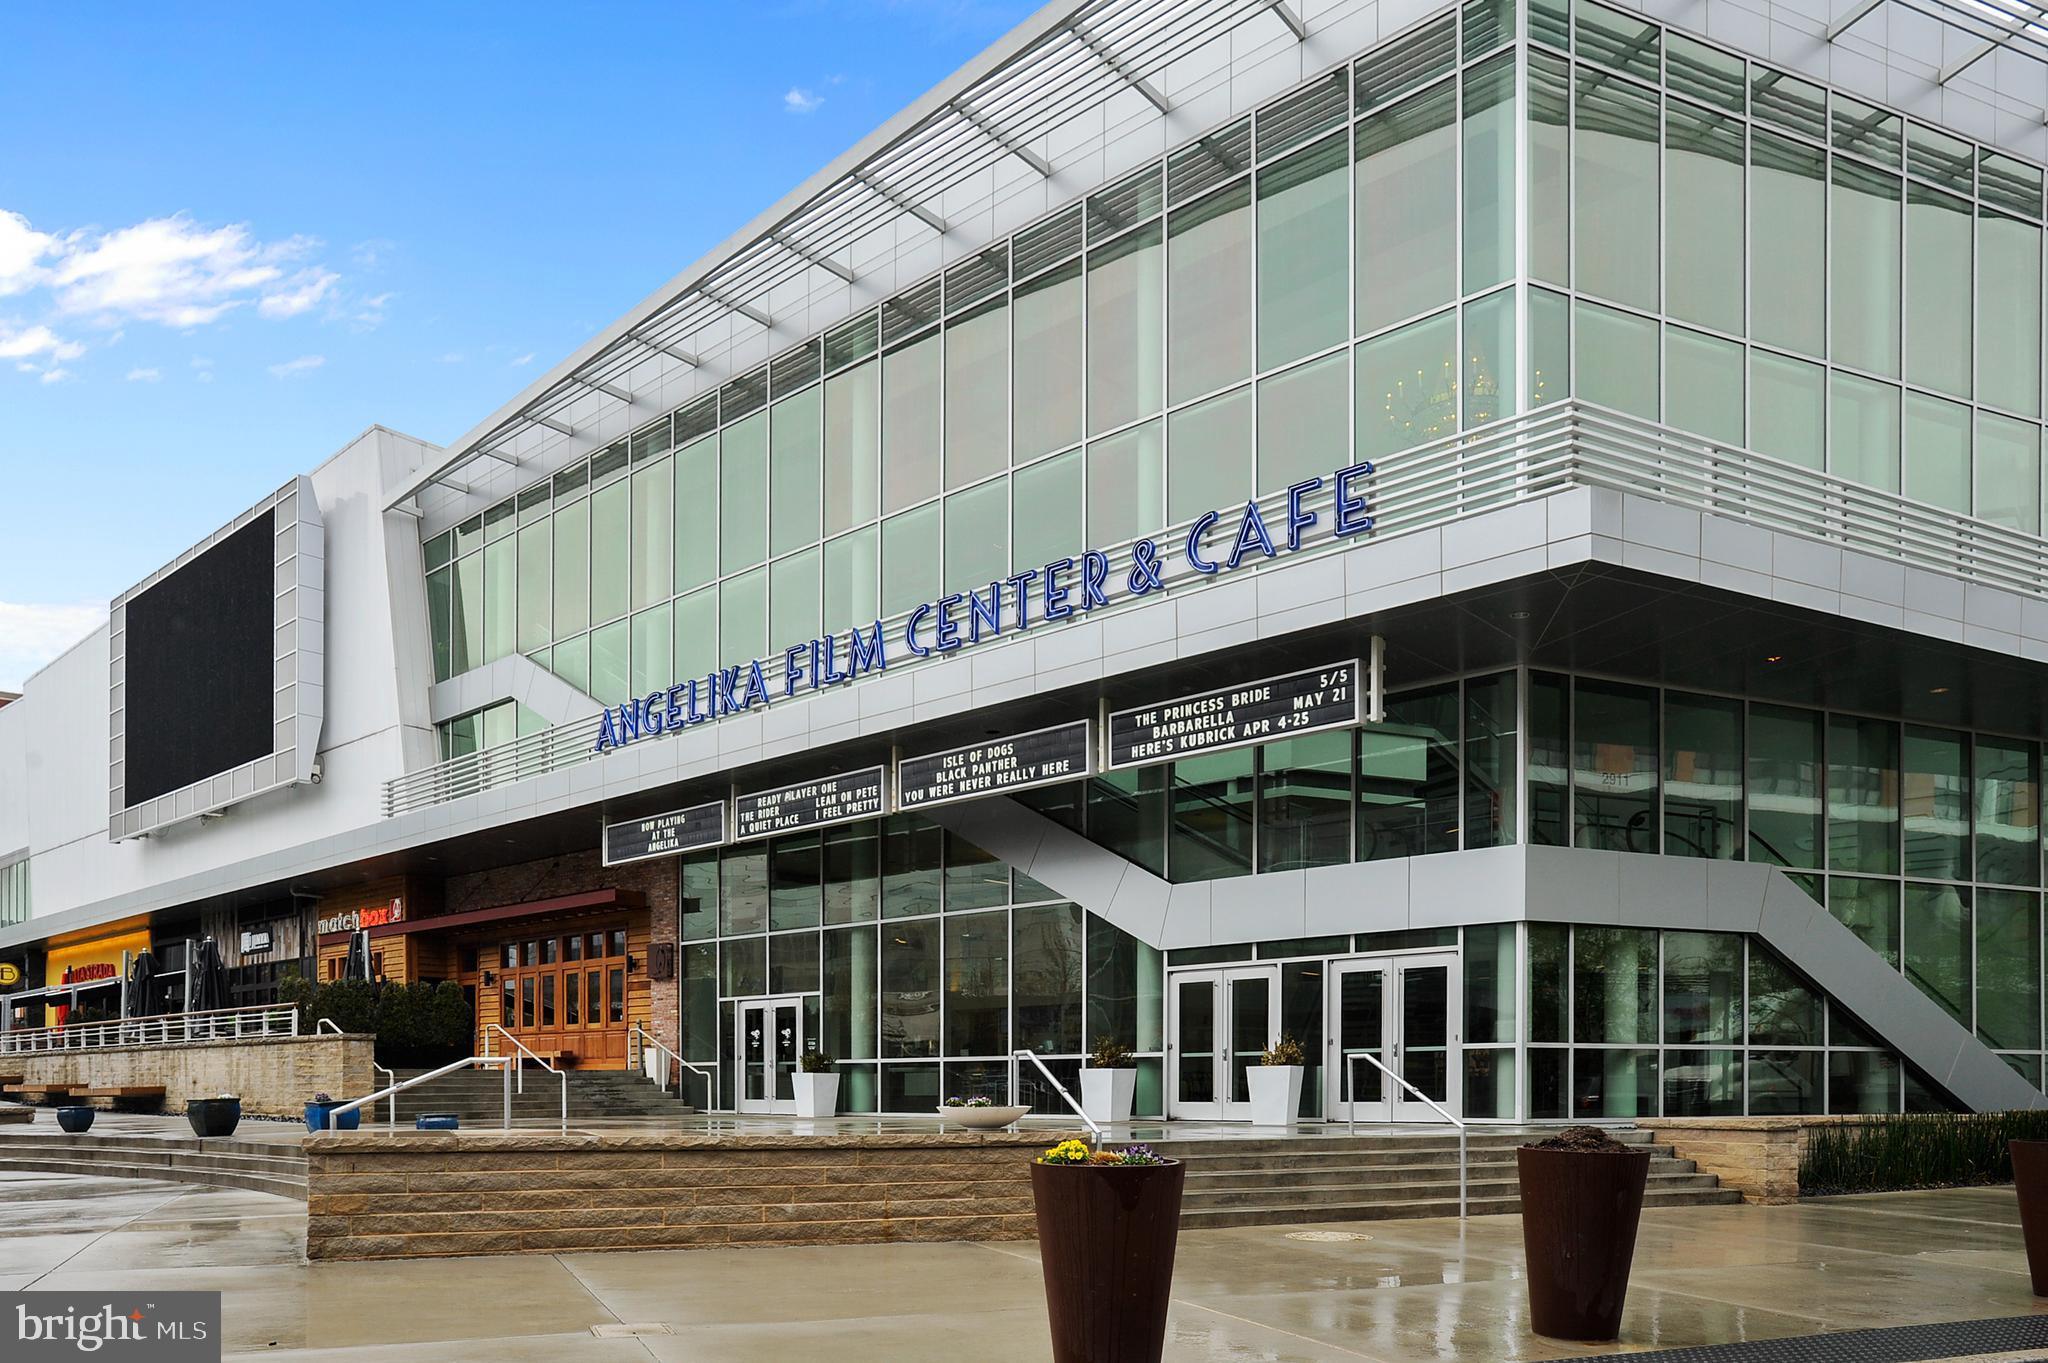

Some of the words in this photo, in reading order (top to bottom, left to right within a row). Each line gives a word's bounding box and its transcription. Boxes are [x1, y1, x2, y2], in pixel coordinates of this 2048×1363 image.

[595, 660, 769, 751] ANGELIKA
[785, 619, 886, 696] FILM
[906, 549, 1109, 657] CENTER
[1127, 538, 1164, 595] &
[1185, 461, 1374, 574] CAFE
[1135, 712, 1157, 728] THE
[1164, 697, 1224, 721] PRINCESS
[1232, 687, 1271, 708] BRIDE
[1320, 669, 1348, 688] 5/5
[1153, 710, 1234, 740] BARBARELLA
[1293, 691, 1324, 710] MAY
[1332, 687, 1347, 702] 21
[1131, 739, 1174, 758] HERE'S
[1180, 725, 1236, 749] KUBRICK
[1243, 719, 1270, 737] APR
[1277, 711, 1310, 730] 4-25
[943, 754, 964, 769] ISLE
[969, 749, 983, 763] OF
[987, 743, 1014, 759] DOGS
[905, 789, 924, 803] YOU
[929, 783, 954, 799] WERE
[959, 775, 991, 792] NEVER
[996, 766, 1036, 785] REALLY
[1042, 759, 1069, 776] HERE
[936, 767, 967, 783] BLACK
[972, 757, 1018, 776] PANTHER
[757, 793, 782, 808] READY
[784, 785, 817, 802] PLAYER
[821, 782, 837, 794] ONE
[815, 794, 837, 808] LEAN
[841, 791, 852, 802] ON
[856, 785, 878, 799] PETE
[740, 812, 754, 823] THE
[757, 806, 780, 820] RIDER
[815, 810, 819, 820] I
[823, 806, 842, 818] FEEL
[846, 798, 879, 814] PRETTY
[641, 821, 655, 832] NOW
[657, 814, 686, 828] PLAYING
[651, 831, 660, 840] AT
[663, 828, 676, 838] THE
[740, 825, 746, 835] A
[749, 820, 772, 833] QUIET
[775, 814, 799, 828] PLACE
[647, 838, 679, 852] ANGELIKA
